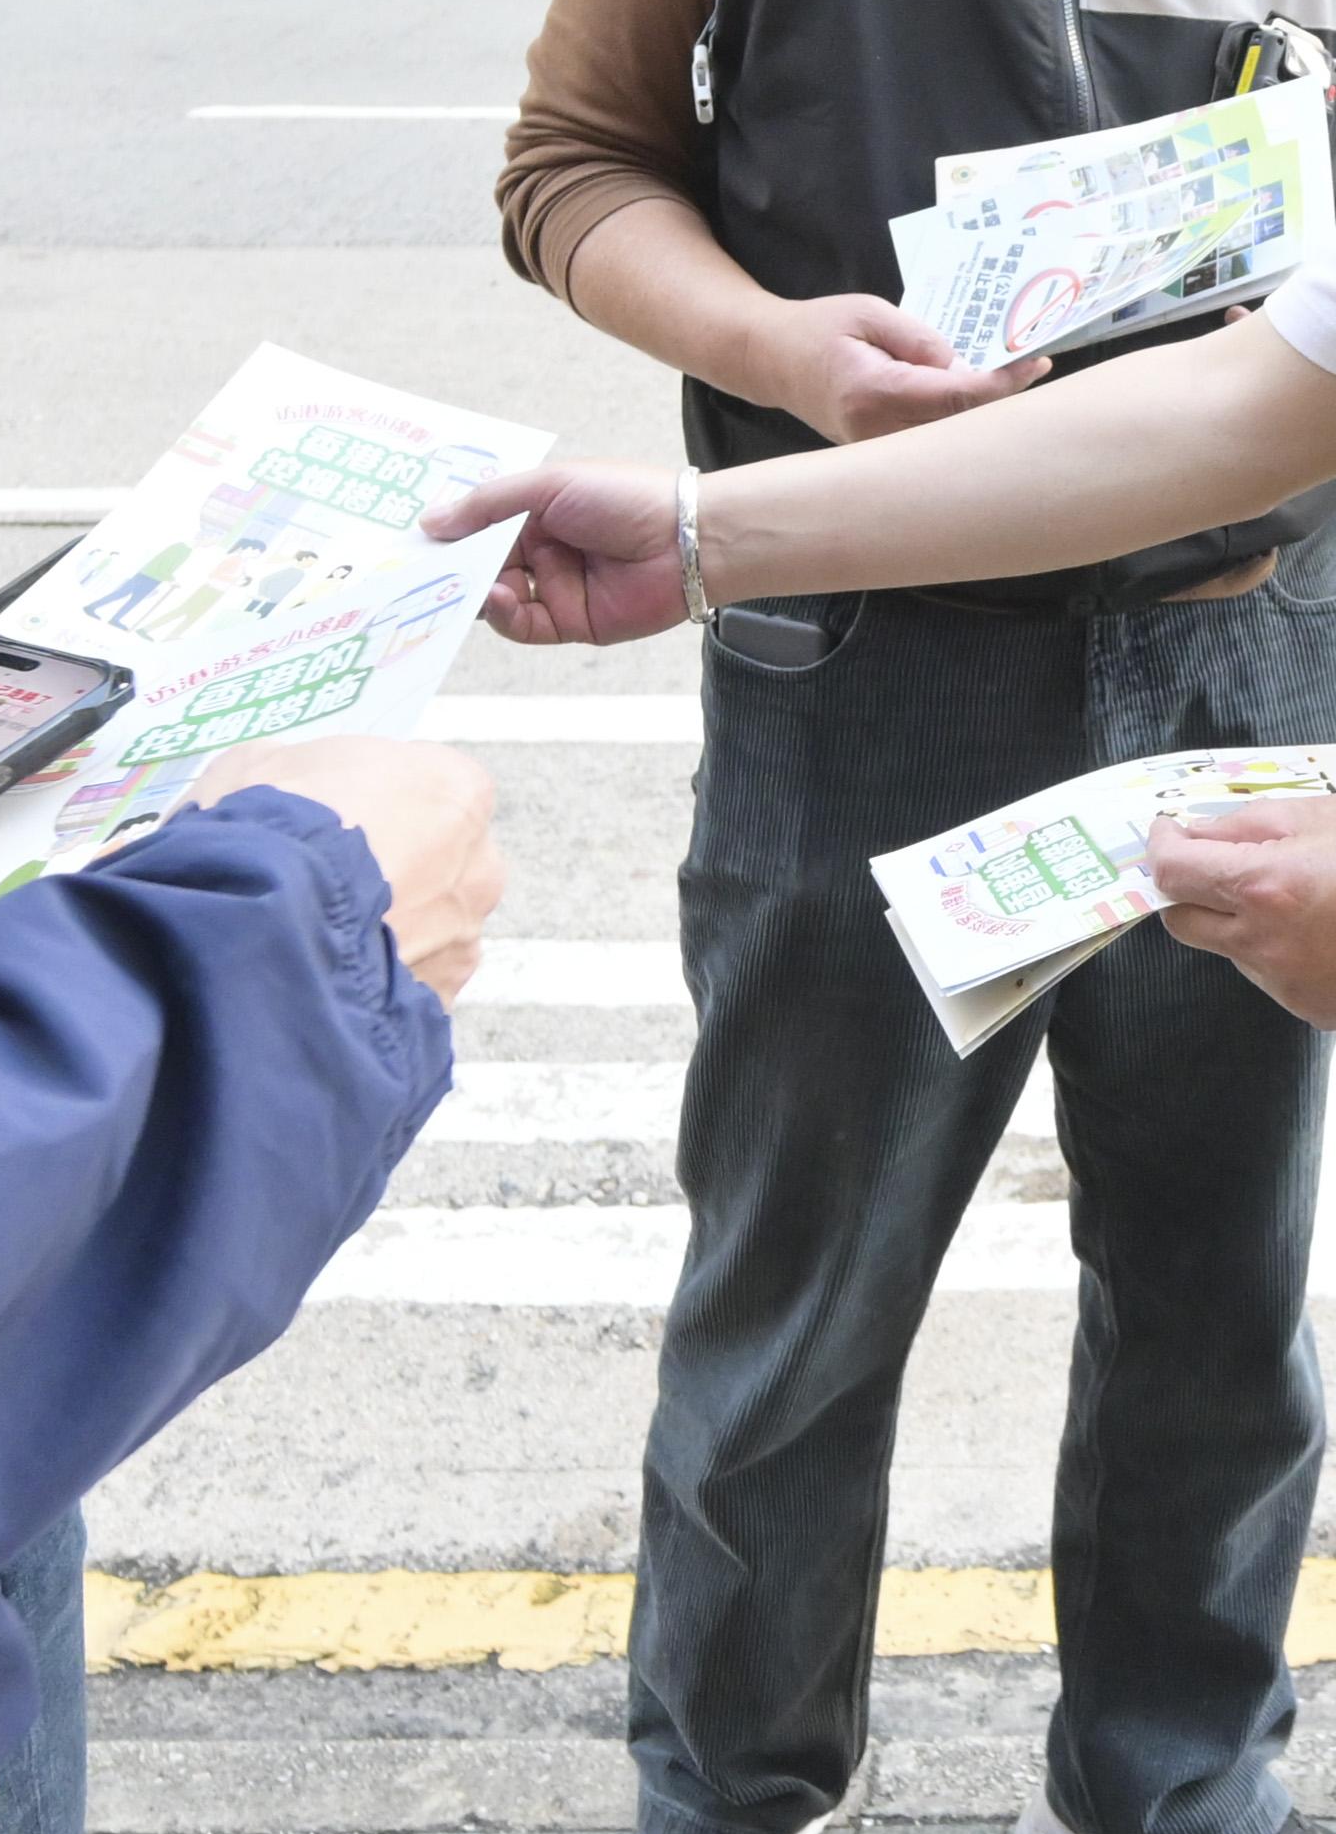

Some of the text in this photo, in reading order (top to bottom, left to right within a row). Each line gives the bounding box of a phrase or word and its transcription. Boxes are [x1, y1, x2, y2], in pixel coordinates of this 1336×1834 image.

[252, 451, 423, 528] 控烟措施
[300, 429, 425, 490] 香港的
[189, 639, 362, 717] 香港的
[124, 671, 367, 764] 控烟措施
